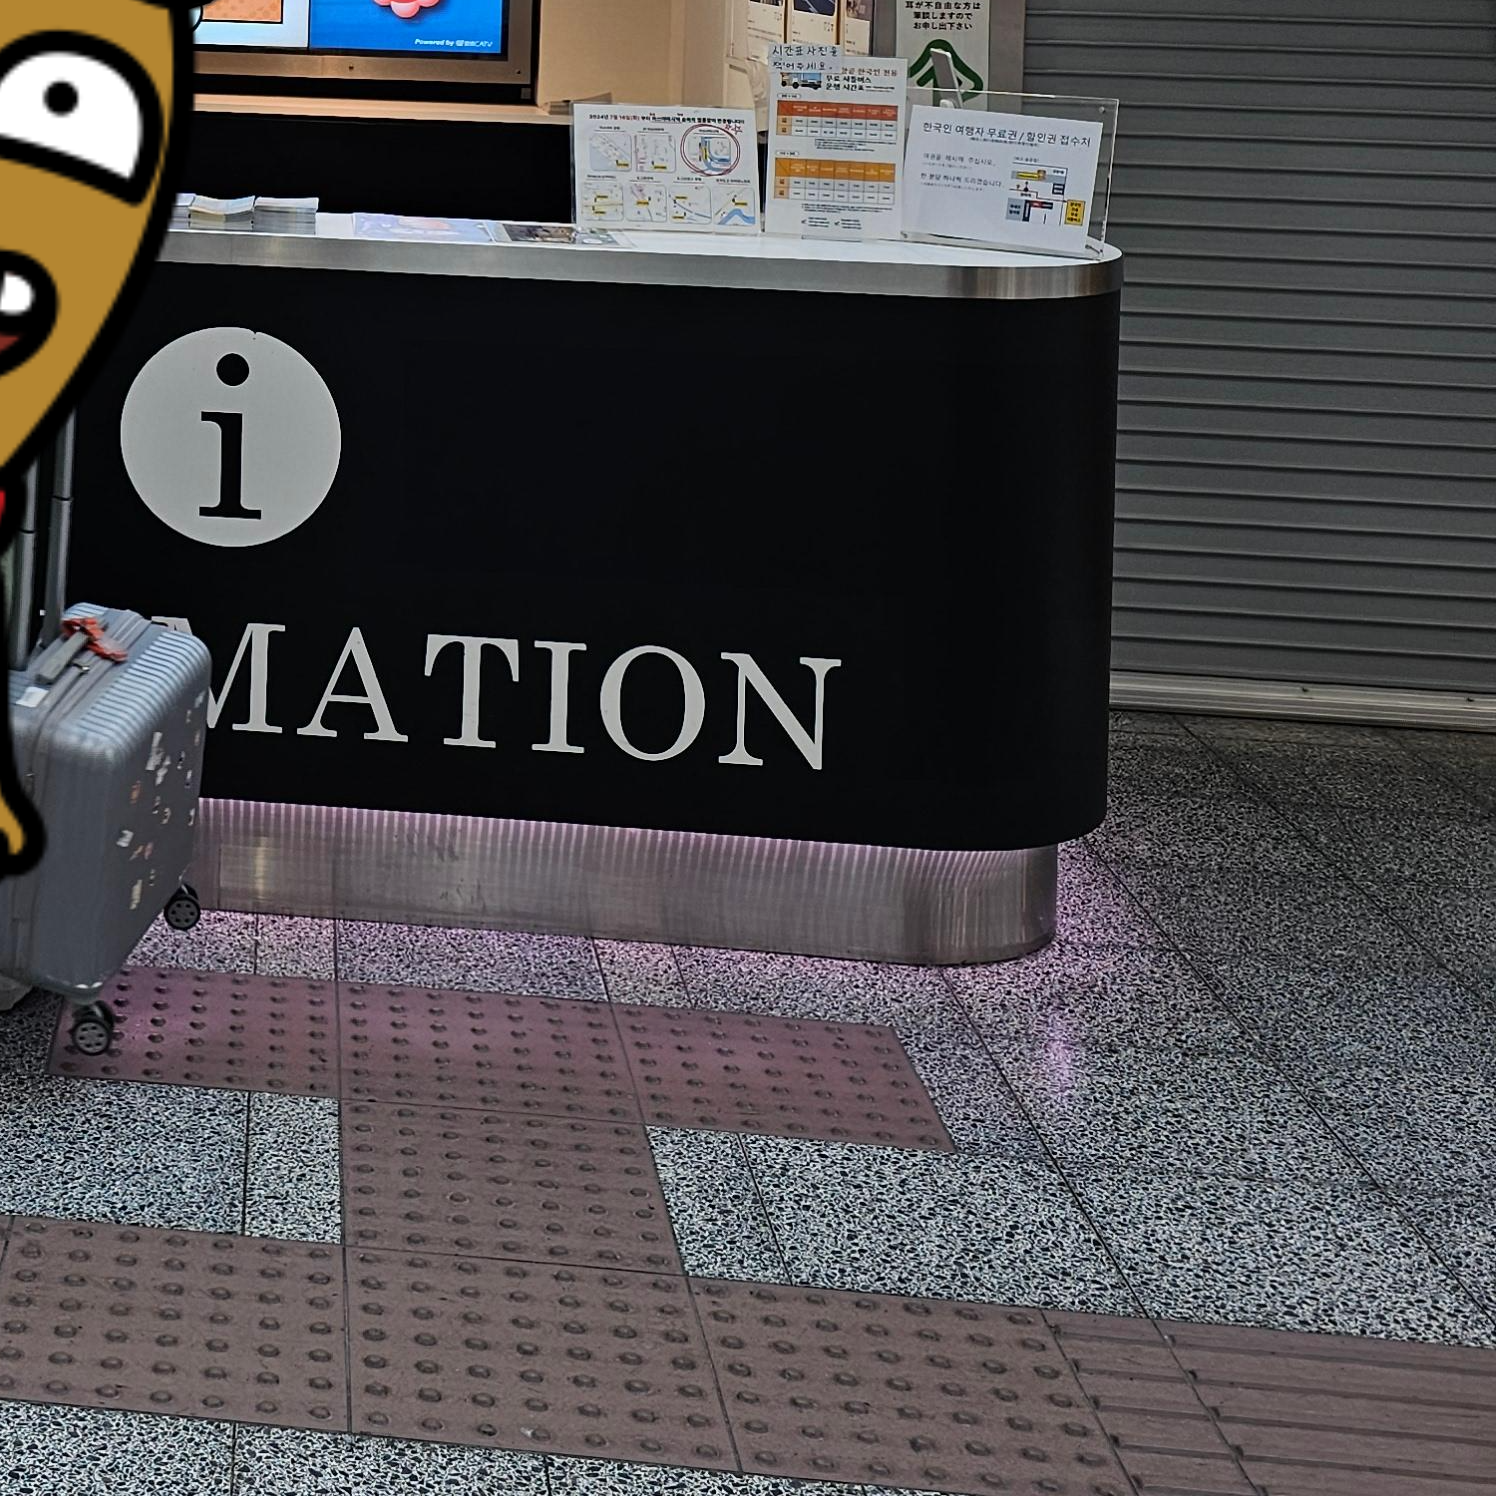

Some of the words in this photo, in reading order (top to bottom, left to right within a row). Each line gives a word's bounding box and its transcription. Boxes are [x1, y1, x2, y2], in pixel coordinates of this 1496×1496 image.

[905, 0, 981, 10] 耳が不自由な方は
[913, 21, 973, 31] お申し出下さい
[923, 121, 953, 135] 한국인
[955, 124, 985, 137] 여행자
[987, 128, 1019, 141] 무료권
[1026, 131, 1057, 145] 할인권
[1060, 134, 1091, 148] 접수처
